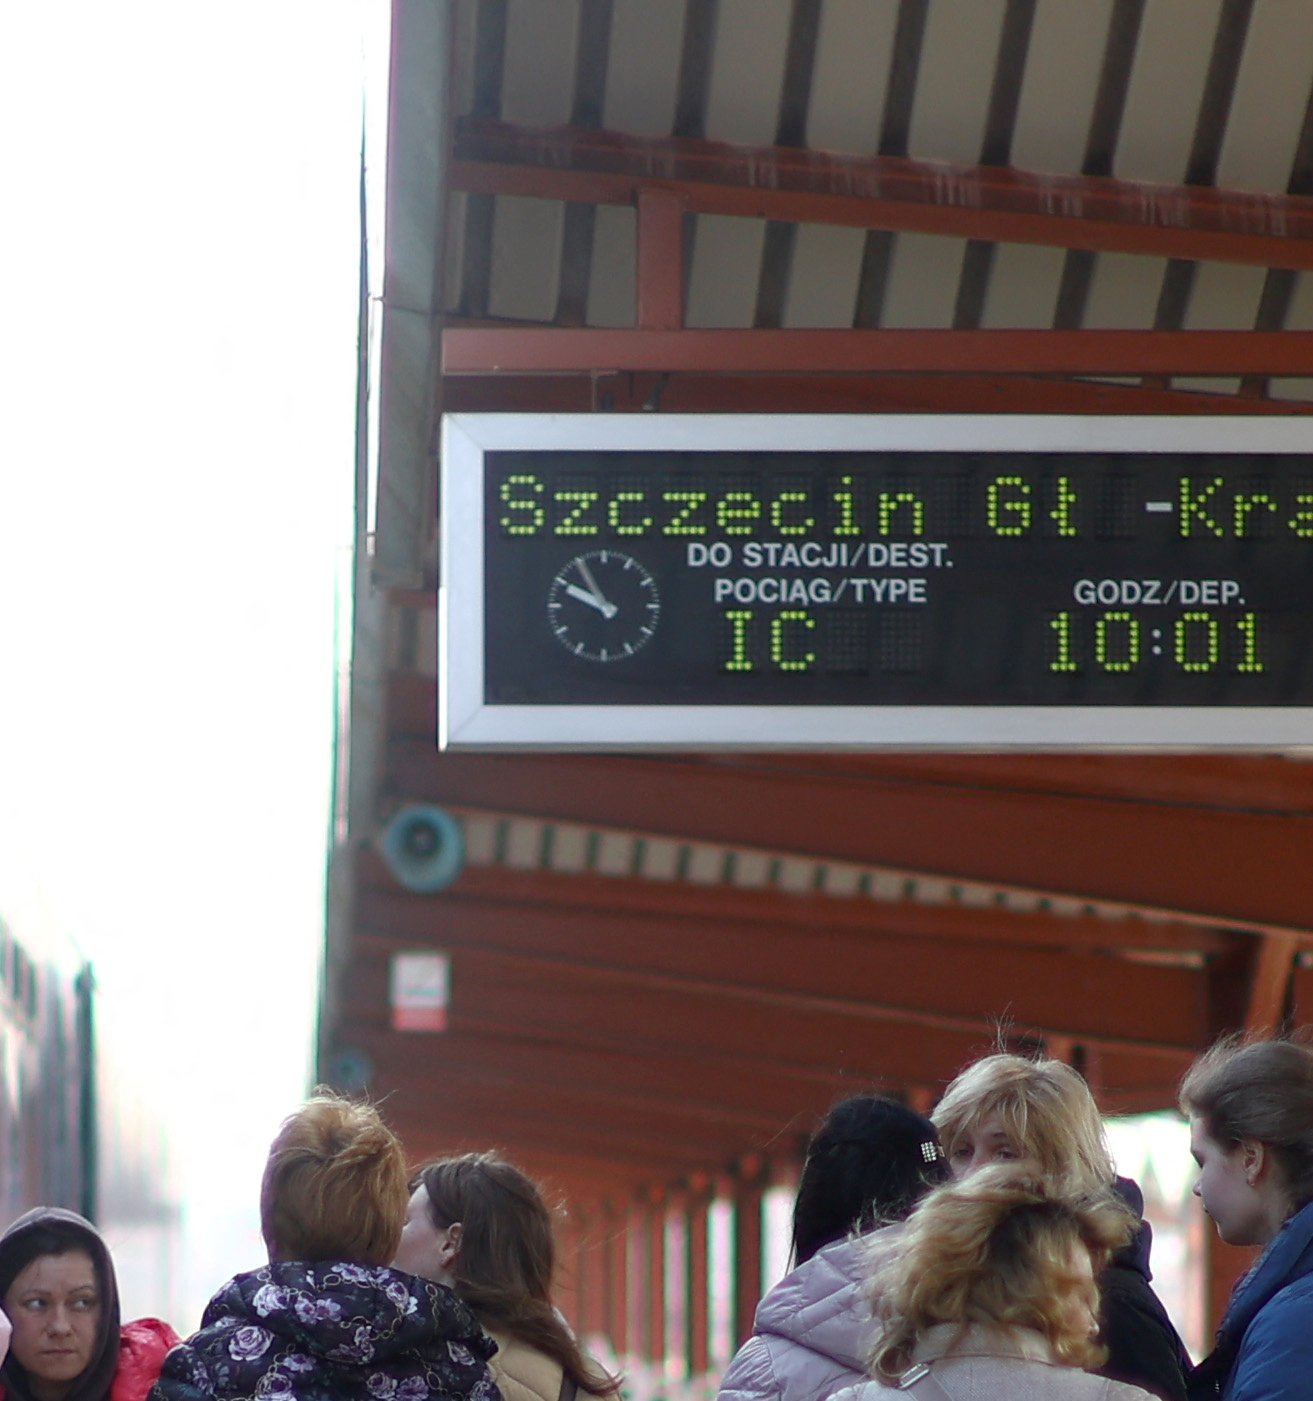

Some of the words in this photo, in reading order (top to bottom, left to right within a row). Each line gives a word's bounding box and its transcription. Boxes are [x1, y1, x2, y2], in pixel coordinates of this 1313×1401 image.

[500, 475, 922, 535] Szczecin
[988, 477, 1075, 535] Gł
[688, 542, 732, 567] DO
[743, 542, 952, 567] STACJI/DEST.
[715, 578, 926, 606] POCIĄG/TYPE
[1074, 580, 1244, 604] GODZ/DEP.
[726, 611, 815, 670] IC
[1051, 613, 1262, 671] 10:01
